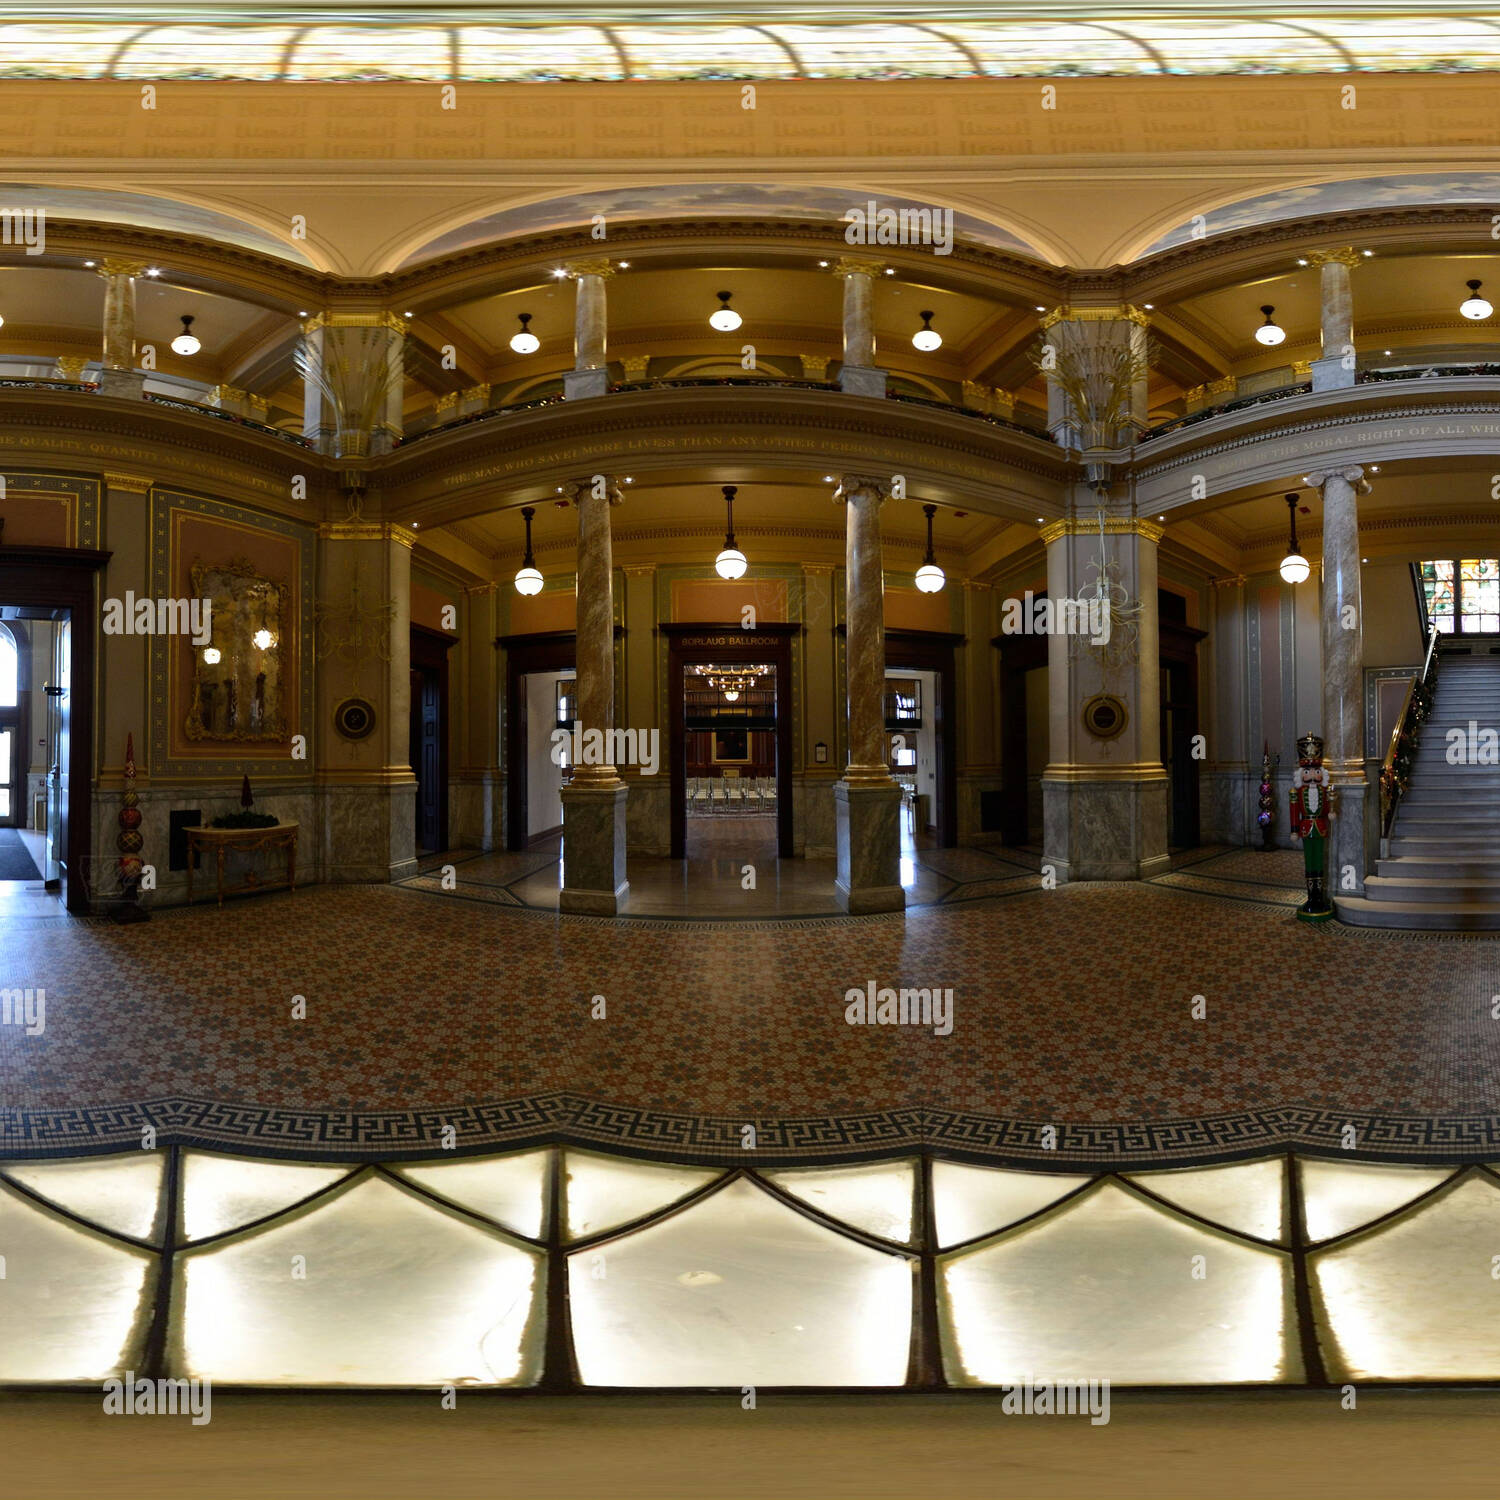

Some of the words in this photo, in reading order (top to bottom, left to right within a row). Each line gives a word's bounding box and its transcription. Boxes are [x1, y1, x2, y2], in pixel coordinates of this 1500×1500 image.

[89, 443, 158, 460] QUANTITY
[1271, 446, 1298, 458] THE
[1302, 436, 1352, 451] MORAL
[1357, 428, 1404, 441] RIGHT
[1408, 426, 1432, 436] OF
[1435, 425, 1465, 435] ALL
[475, 465, 502, 479] MAN
[503, 457, 535, 471] WHO
[583, 442, 623, 455] MORE
[680, 437, 722, 447] THAN
[726, 437, 758, 446] ANY
[764, 437, 816, 448] OTHER
[821, 440, 879, 455] PERSON
[682, 637, 726, 646] BORLAUG
[728, 637, 779, 646] BALLROOM
